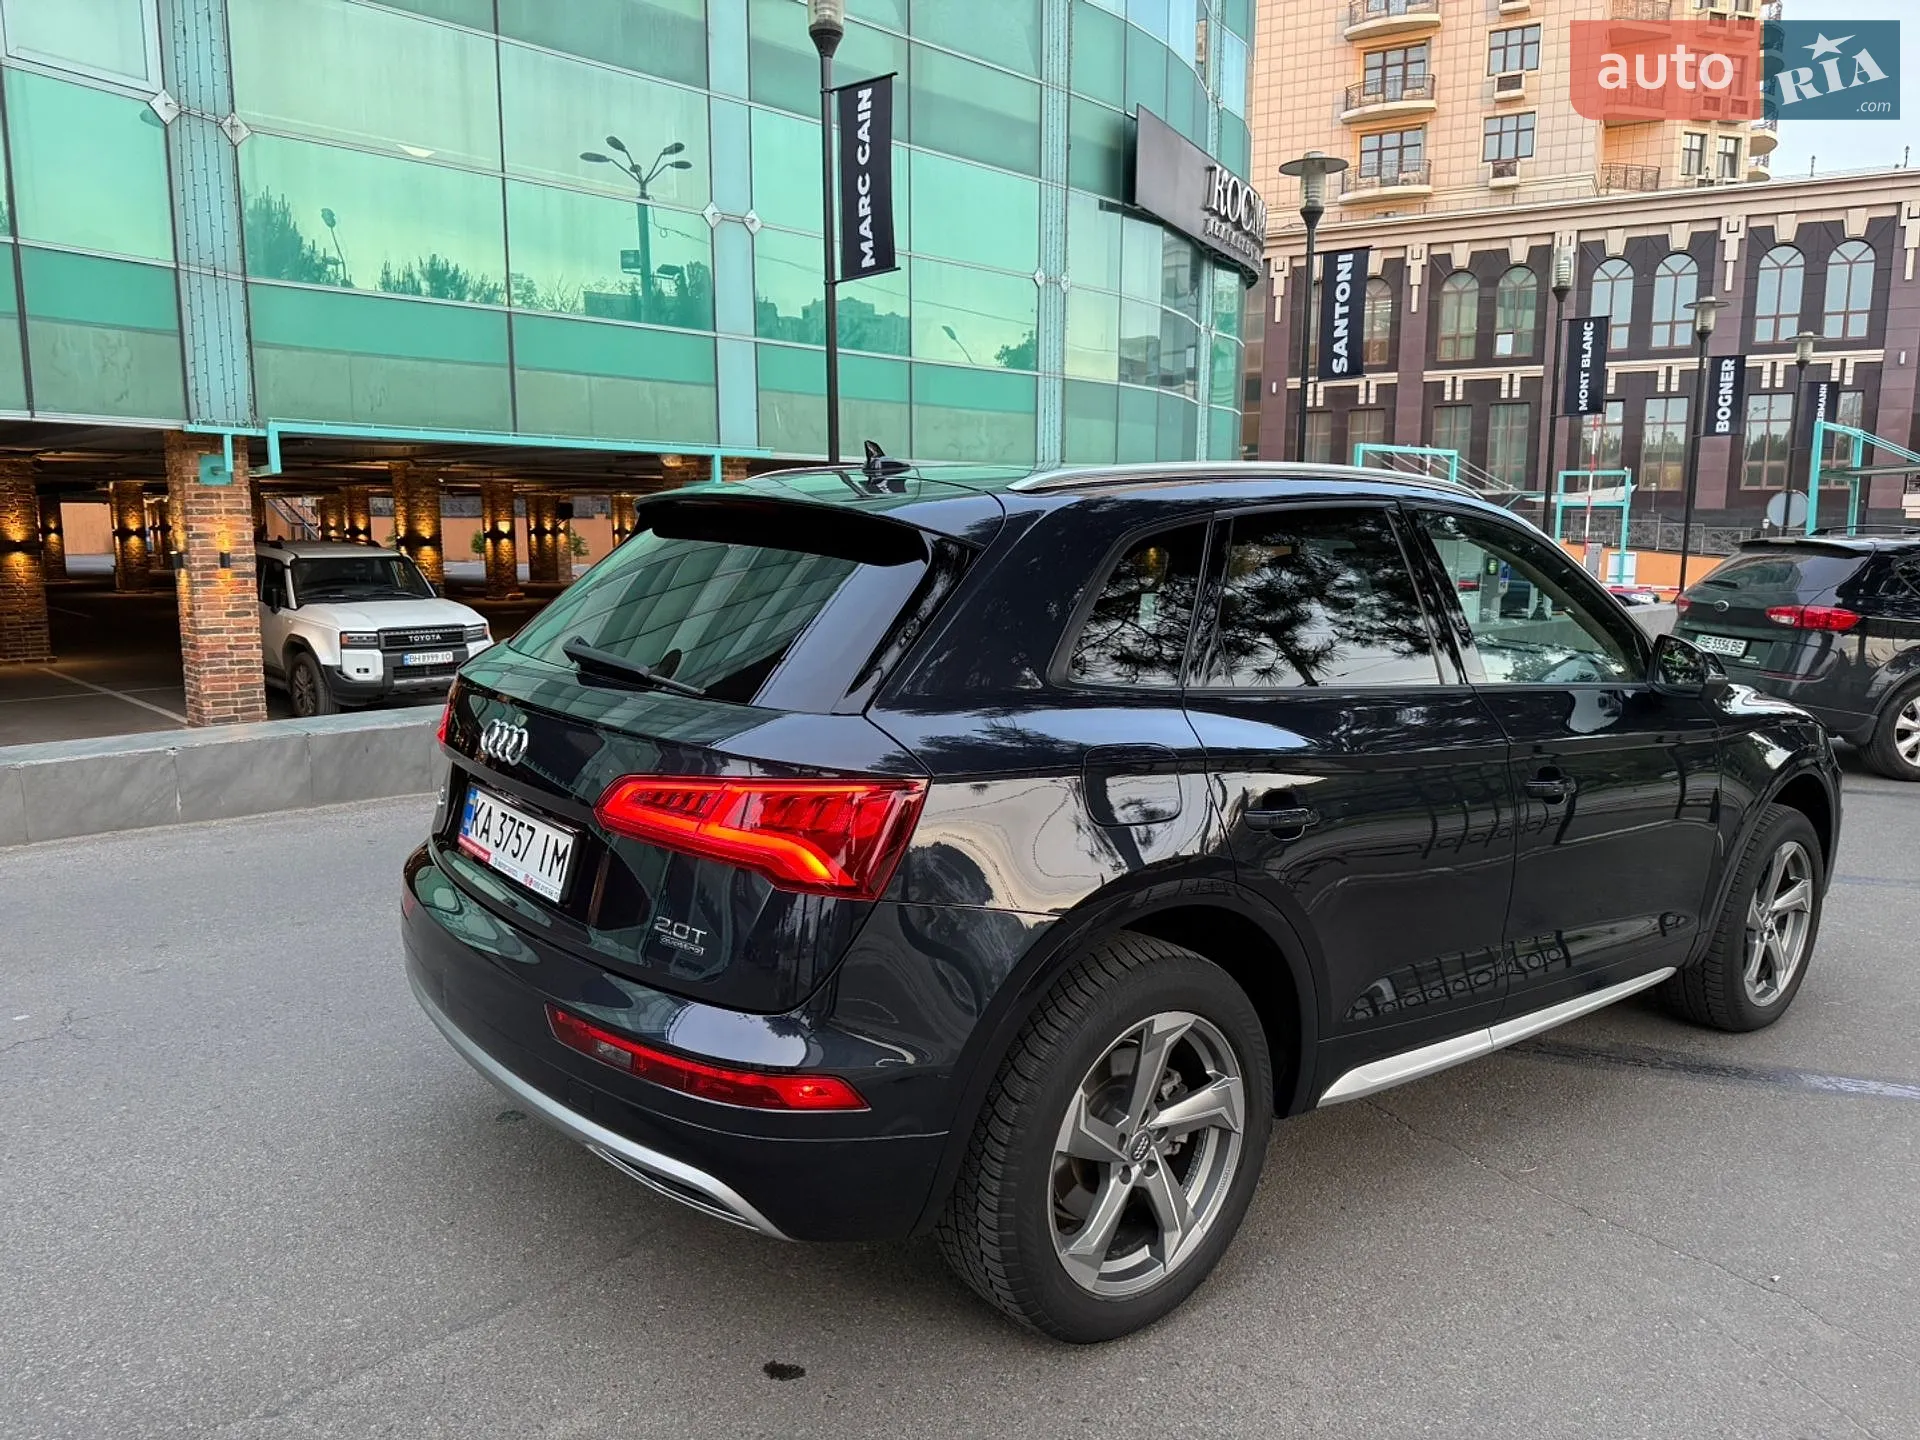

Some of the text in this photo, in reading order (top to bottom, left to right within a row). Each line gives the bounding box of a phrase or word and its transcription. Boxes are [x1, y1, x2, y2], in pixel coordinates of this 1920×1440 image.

[857, 87, 876, 268] MARC CAIN
[1332, 253, 1354, 374] SANTONI
[1578, 321, 1595, 411] MONT BLANC
[1715, 358, 1736, 433] BOGNER
[408, 633, 442, 642] TOYOTA
[470, 799, 493, 842] KA
[494, 811, 536, 863] 3757
[538, 833, 570, 882] IM
